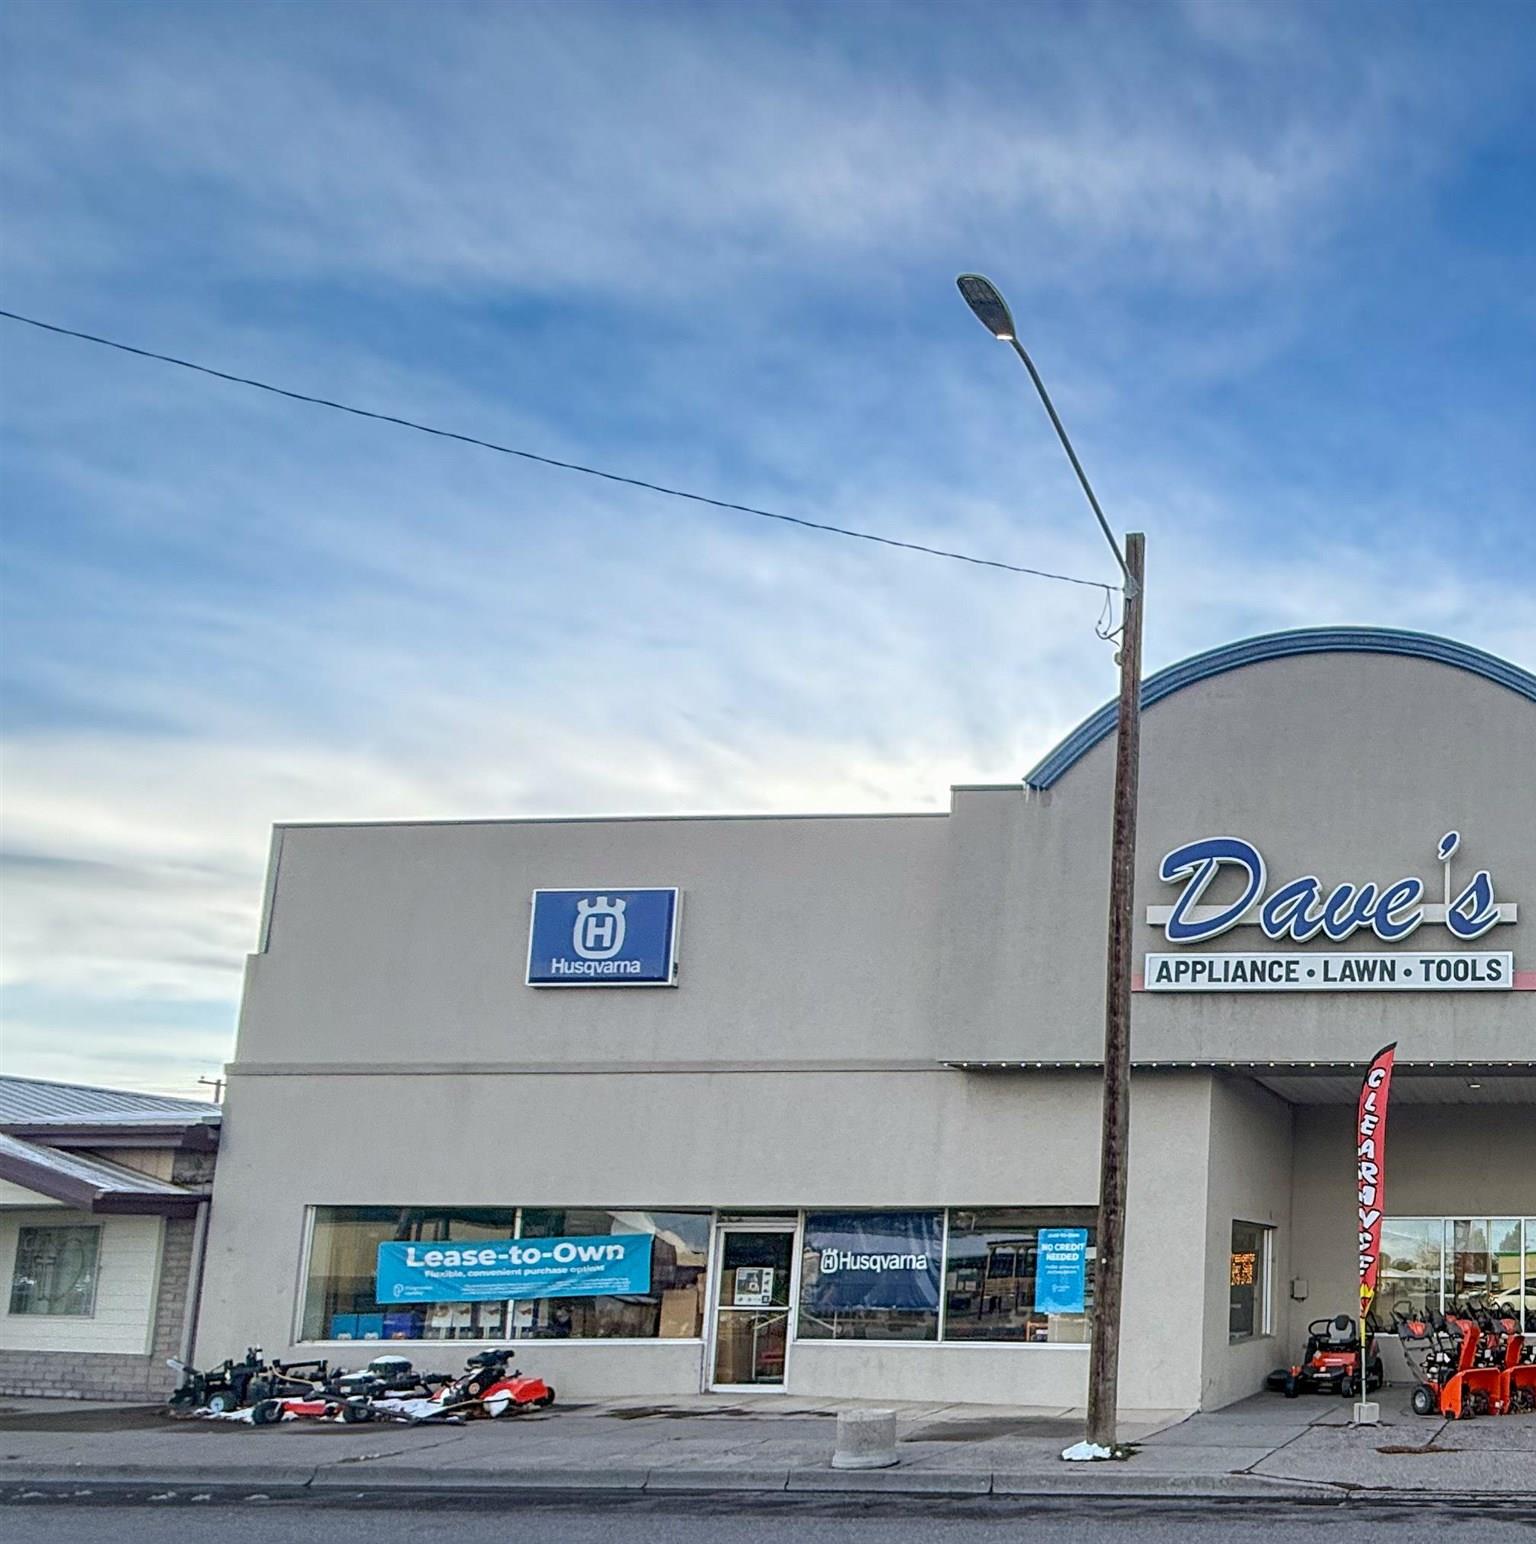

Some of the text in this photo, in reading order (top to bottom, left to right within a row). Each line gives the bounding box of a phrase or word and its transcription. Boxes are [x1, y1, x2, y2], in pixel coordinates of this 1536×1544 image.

[1159, 830, 1502, 944] Dave's
[551, 958, 641, 976] Husqvarna
[1155, 958, 1502, 983] APPLIANCE LAWN TOOLS
[405, 1242, 625, 1268] Lease-to-Own
[1041, 1243, 1084, 1251] NO CREDIT
[1046, 1253, 1080, 1261] NEEDED
[467, 1268, 522, 1277] convenient
[523, 1266, 569, 1277] purchase
[838, 1250, 928, 1273] Husqvarna
